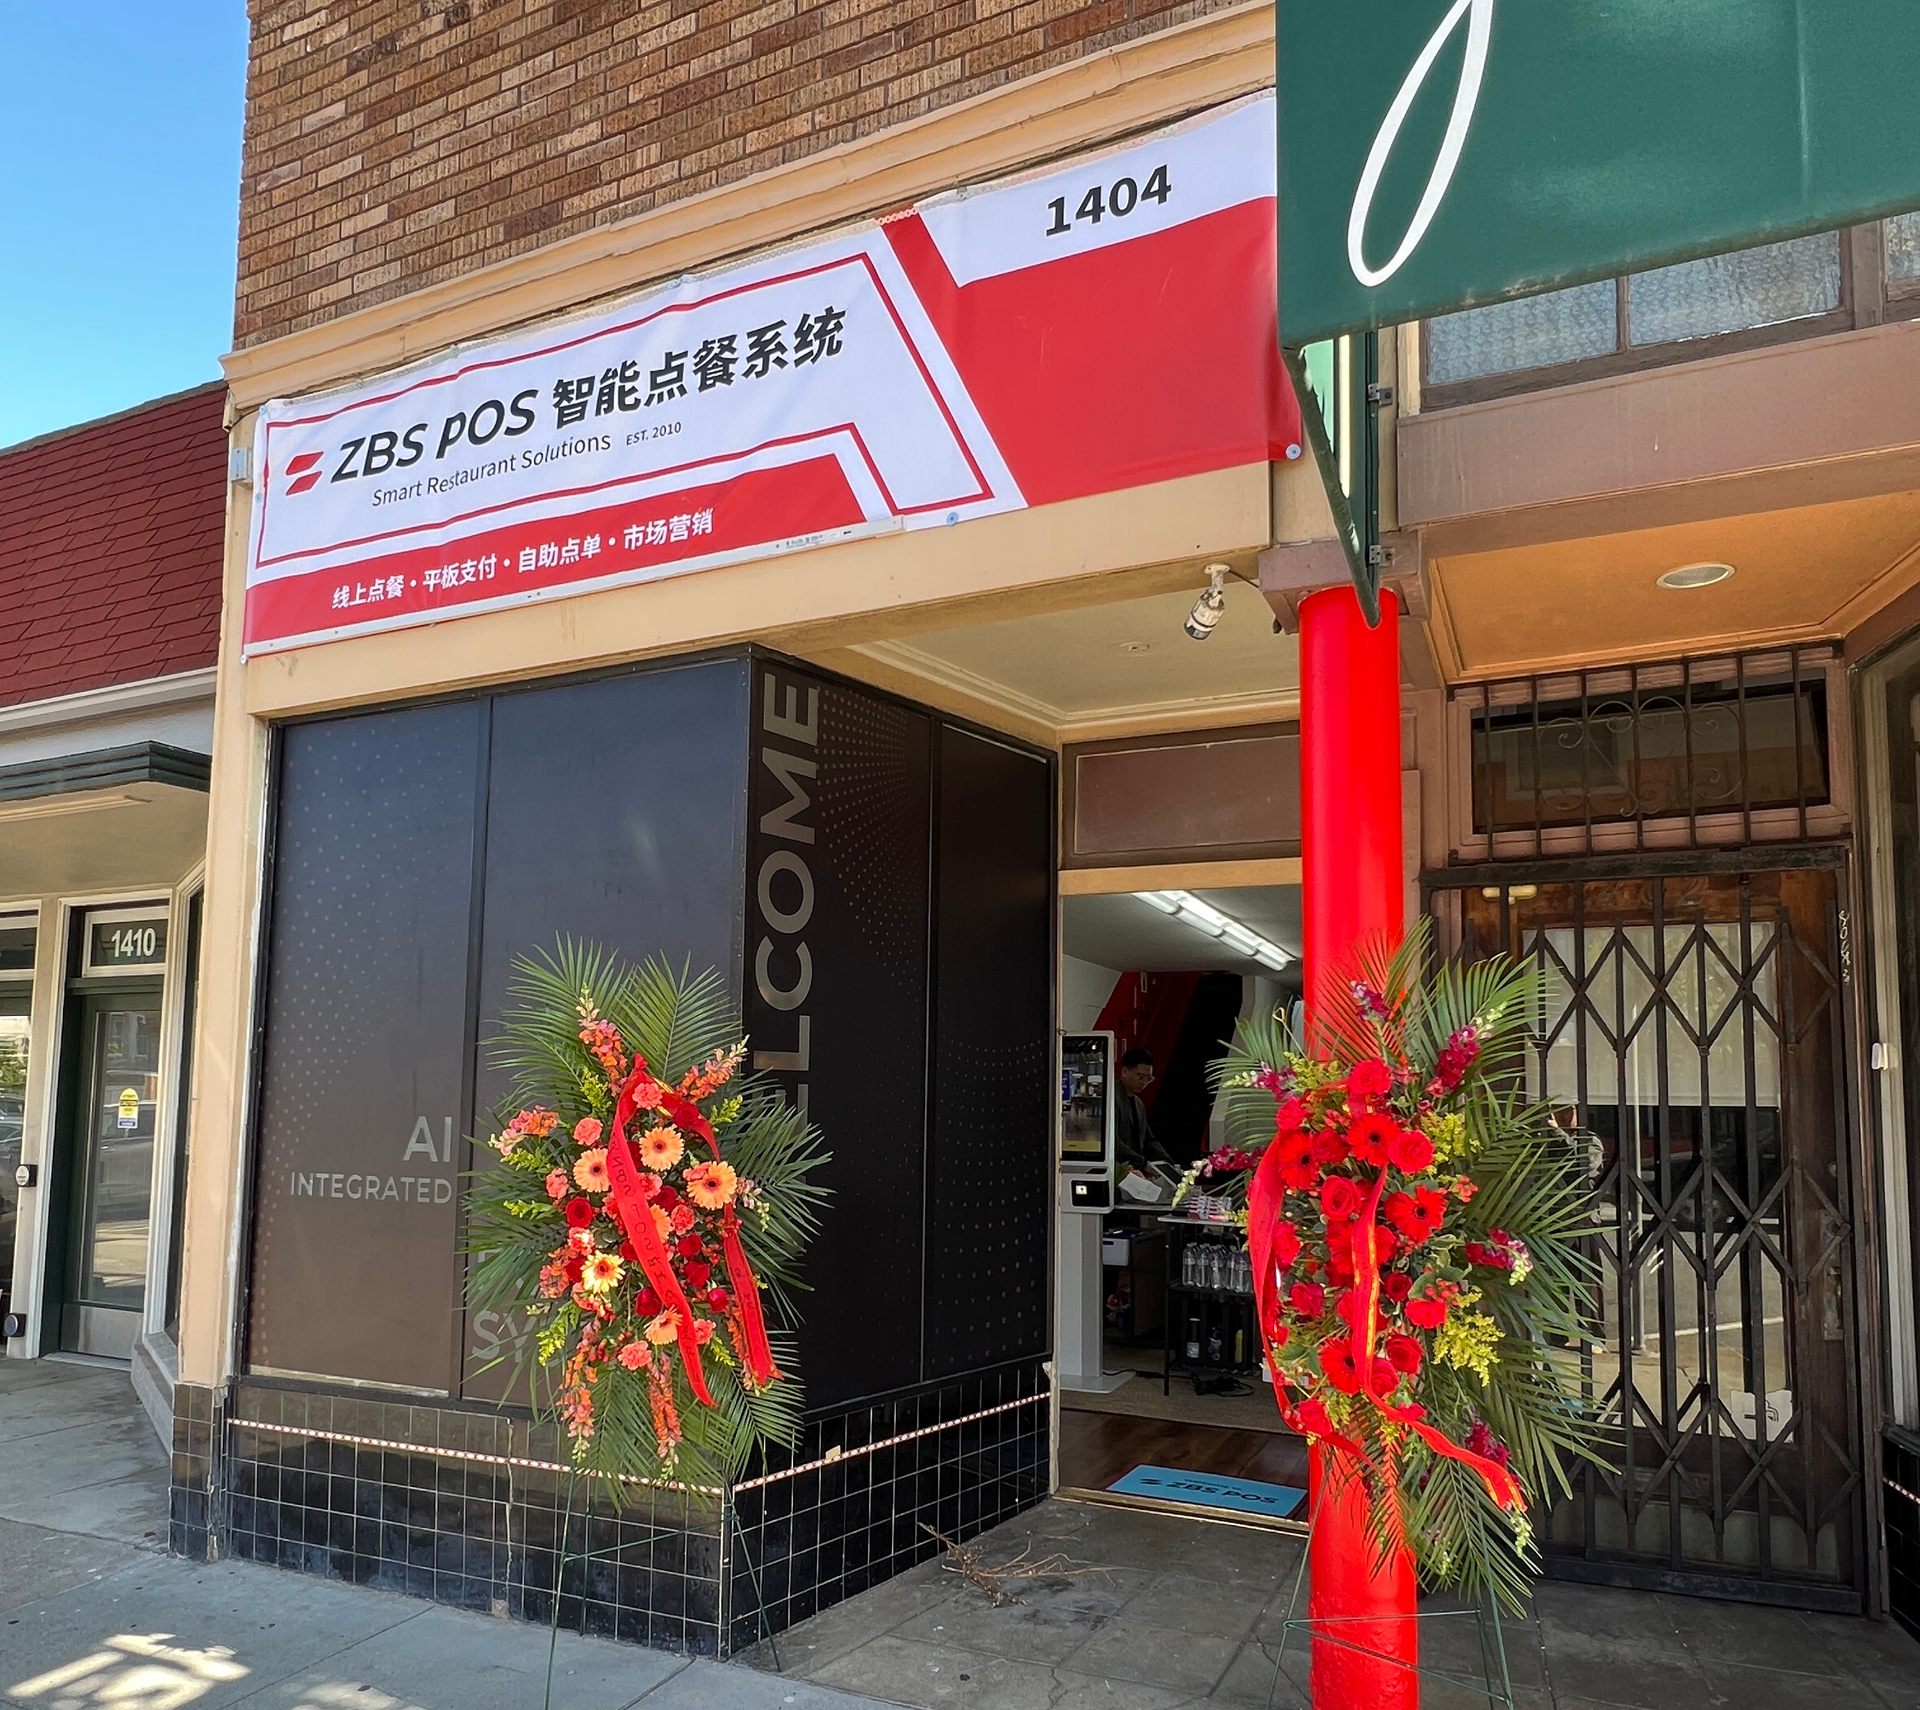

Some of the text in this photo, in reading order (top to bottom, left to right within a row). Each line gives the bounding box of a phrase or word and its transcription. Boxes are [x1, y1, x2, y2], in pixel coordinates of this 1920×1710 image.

[1045, 165, 1172, 236] 1404
[330, 306, 846, 483] ZBS POS 智能点餐系统
[372, 421, 682, 507] Smart Restaurant Solutions EST. 2010
[111, 928, 156, 957] 1410
[402, 1115, 453, 1163] AI
[289, 1172, 453, 1204] INTEGRATED
[1166, 1481, 1220, 1494] ZBS
[1222, 1490, 1279, 1504] POS
